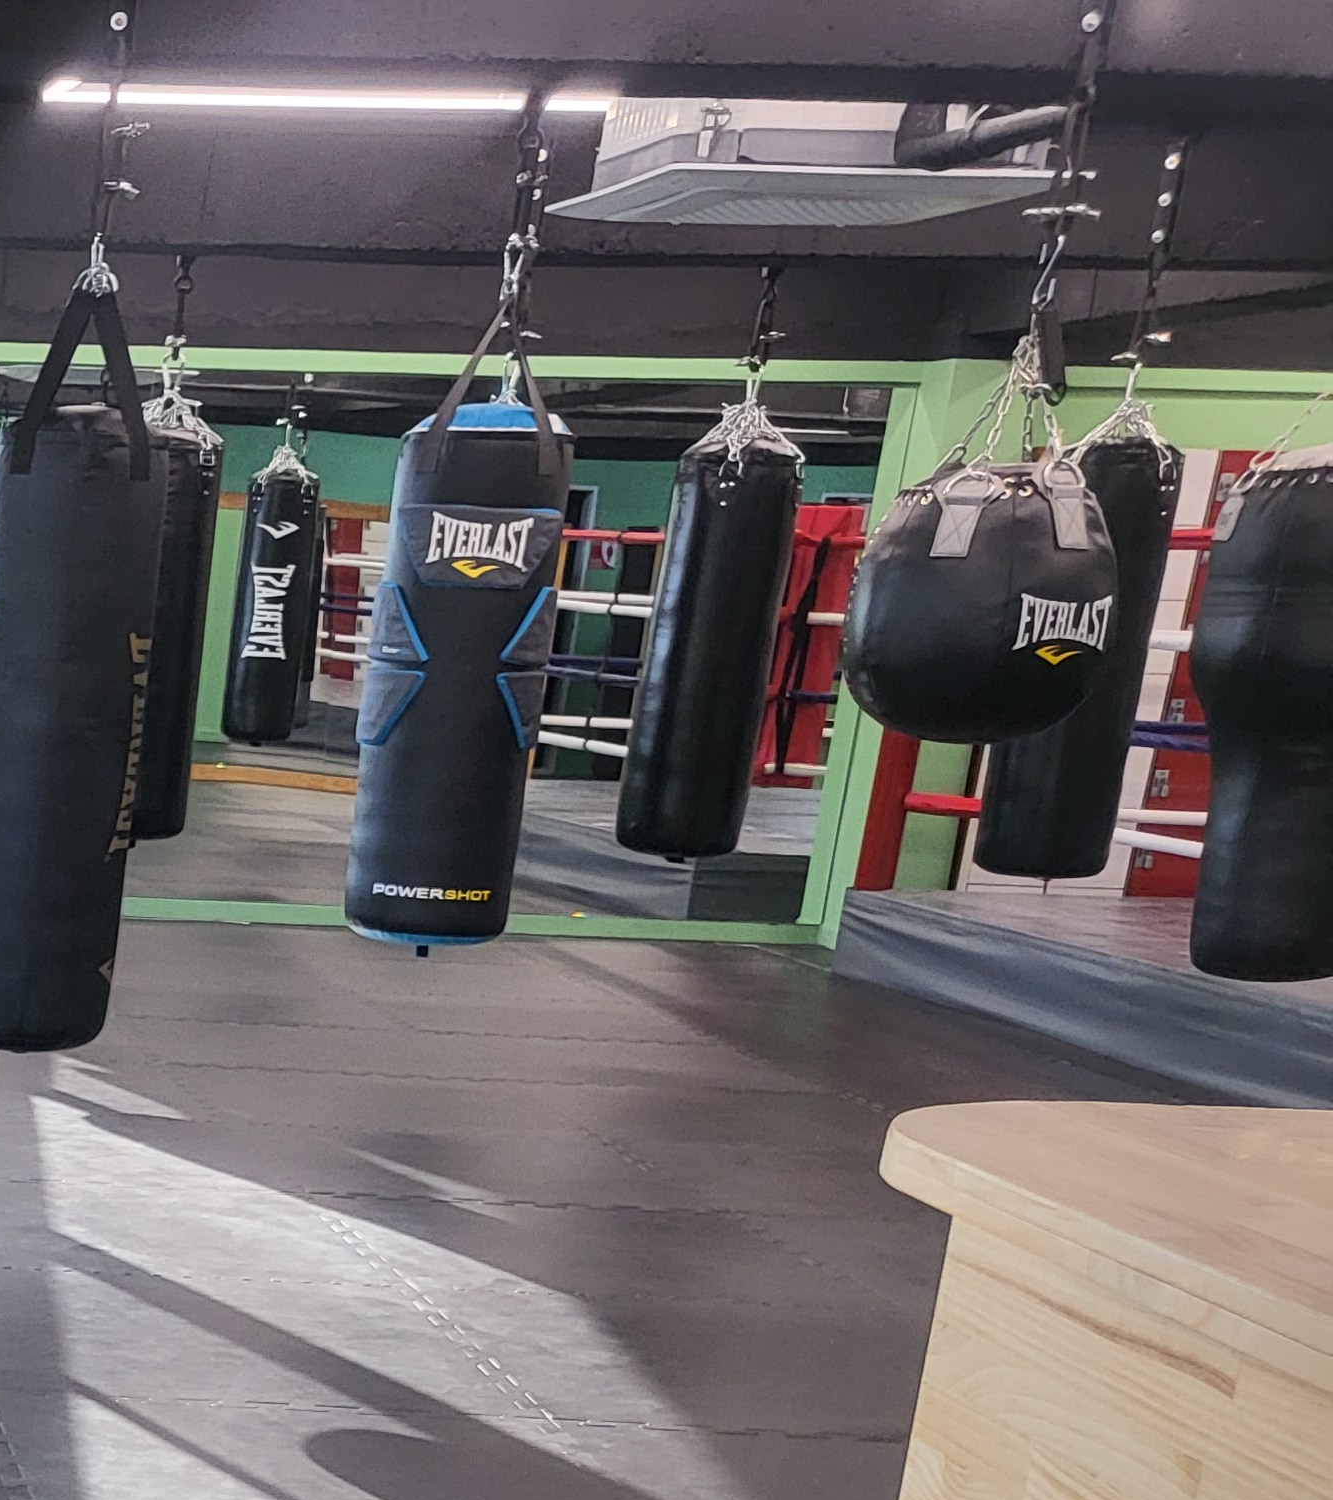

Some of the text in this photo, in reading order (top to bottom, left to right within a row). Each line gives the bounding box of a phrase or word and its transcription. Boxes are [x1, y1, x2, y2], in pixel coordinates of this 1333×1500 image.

[425, 511, 535, 573] EVERLAST
[1012, 593, 1114, 652] EVERLAST
[372, 882, 492, 903] POWERSHOT
